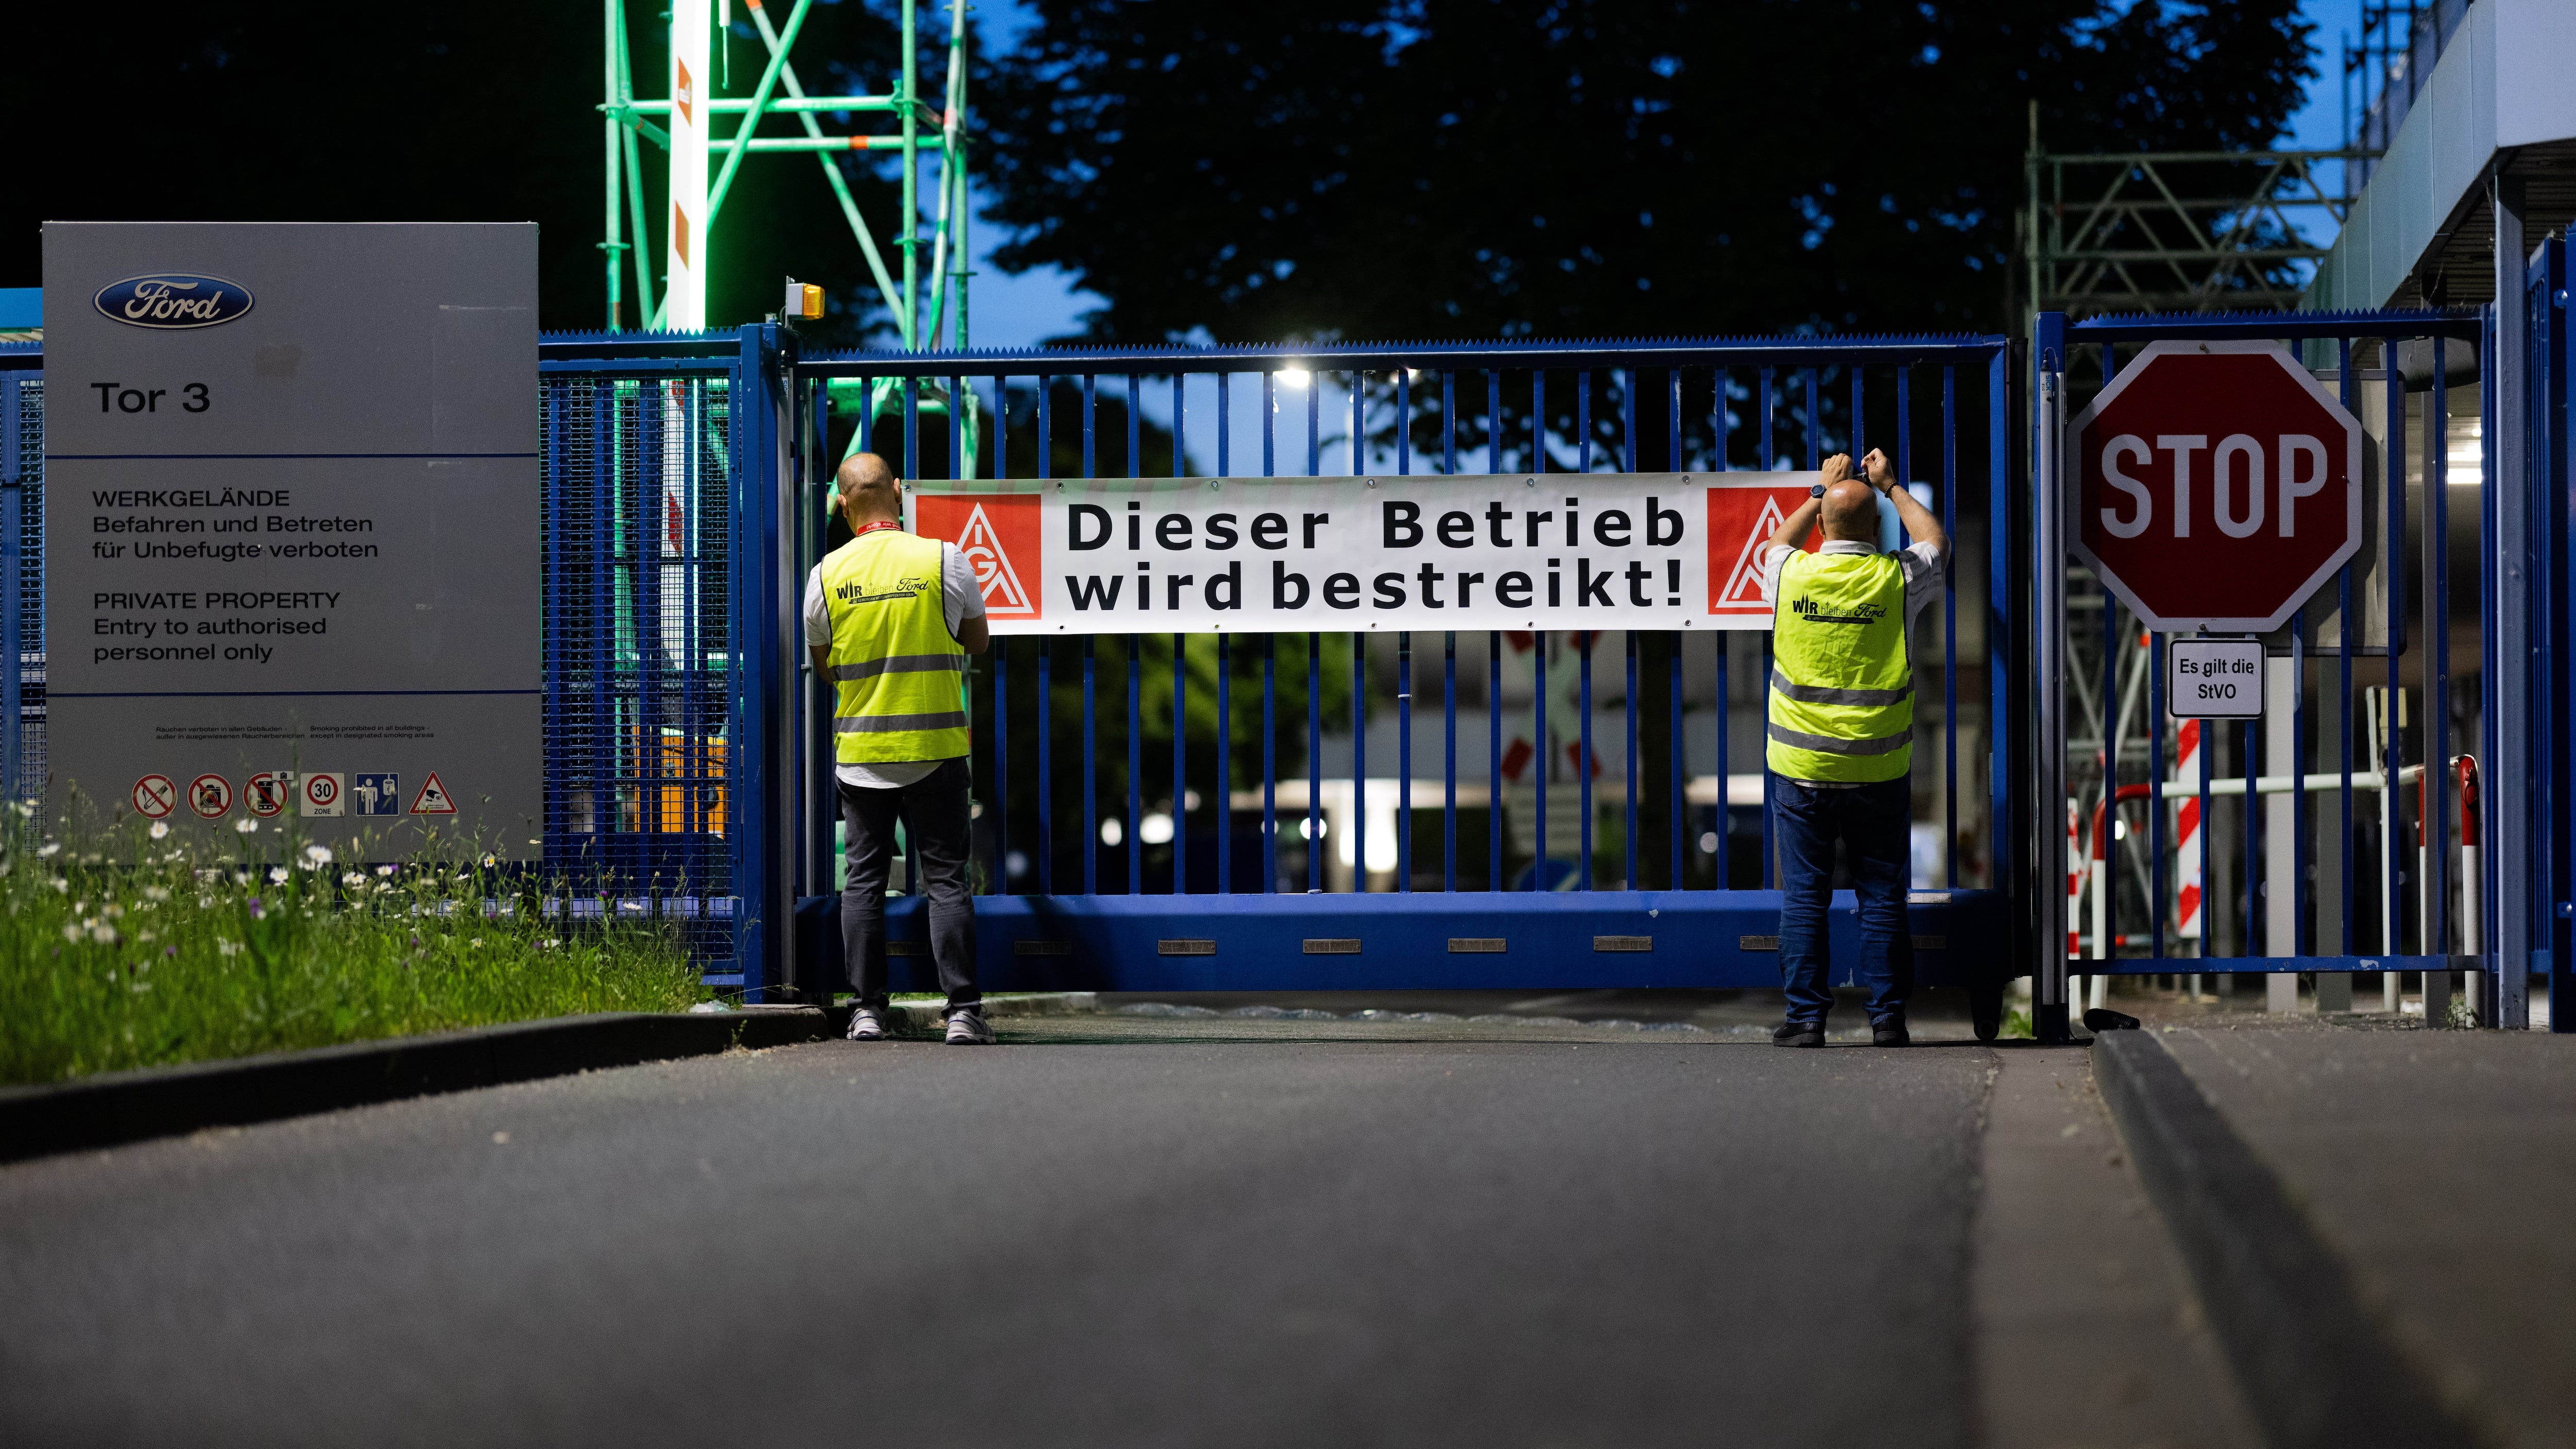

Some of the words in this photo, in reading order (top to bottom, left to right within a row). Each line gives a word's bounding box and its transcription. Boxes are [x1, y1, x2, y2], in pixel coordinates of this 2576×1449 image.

[125, 279, 221, 319] Ford
[91, 383, 166, 413] Tor
[182, 383, 210, 413] 3
[2100, 433, 2328, 539] STOP
[93, 487, 290, 507] WERKGELÄNDE
[94, 516, 205, 533] Befahren
[214, 516, 258, 533] und
[267, 516, 372, 532] Betreten
[1068, 501, 1329, 551] Dieser
[1383, 497, 1684, 548] Betrieb
[93, 541, 126, 558] für
[134, 541, 260, 562] Unbefugte
[269, 541, 378, 558] verboten
[837, 578, 862, 599] WIR
[866, 580, 893, 596] bleiben
[896, 577, 929, 591] Ford
[1065, 560, 1241, 611] wird
[1273, 558, 1681, 610] bestreikt!
[94, 592, 197, 609] PRIVATE
[206, 592, 340, 609] PROPERTY
[1793, 593, 1818, 614] WIR
[1821, 598, 1851, 616] bleiben
[1854, 603, 1888, 618] Ford
[94, 619, 157, 639] Entry
[164, 619, 189, 635] to
[197, 618, 326, 635] authorised
[94, 643, 215, 664] personnel
[224, 643, 273, 664] only
[2180, 658, 2198, 674] Es
[2202, 658, 2227, 678] gilt
[2231, 658, 2254, 674] die
[2198, 684, 2236, 699] StVO
[315, 783, 331, 798] 30
